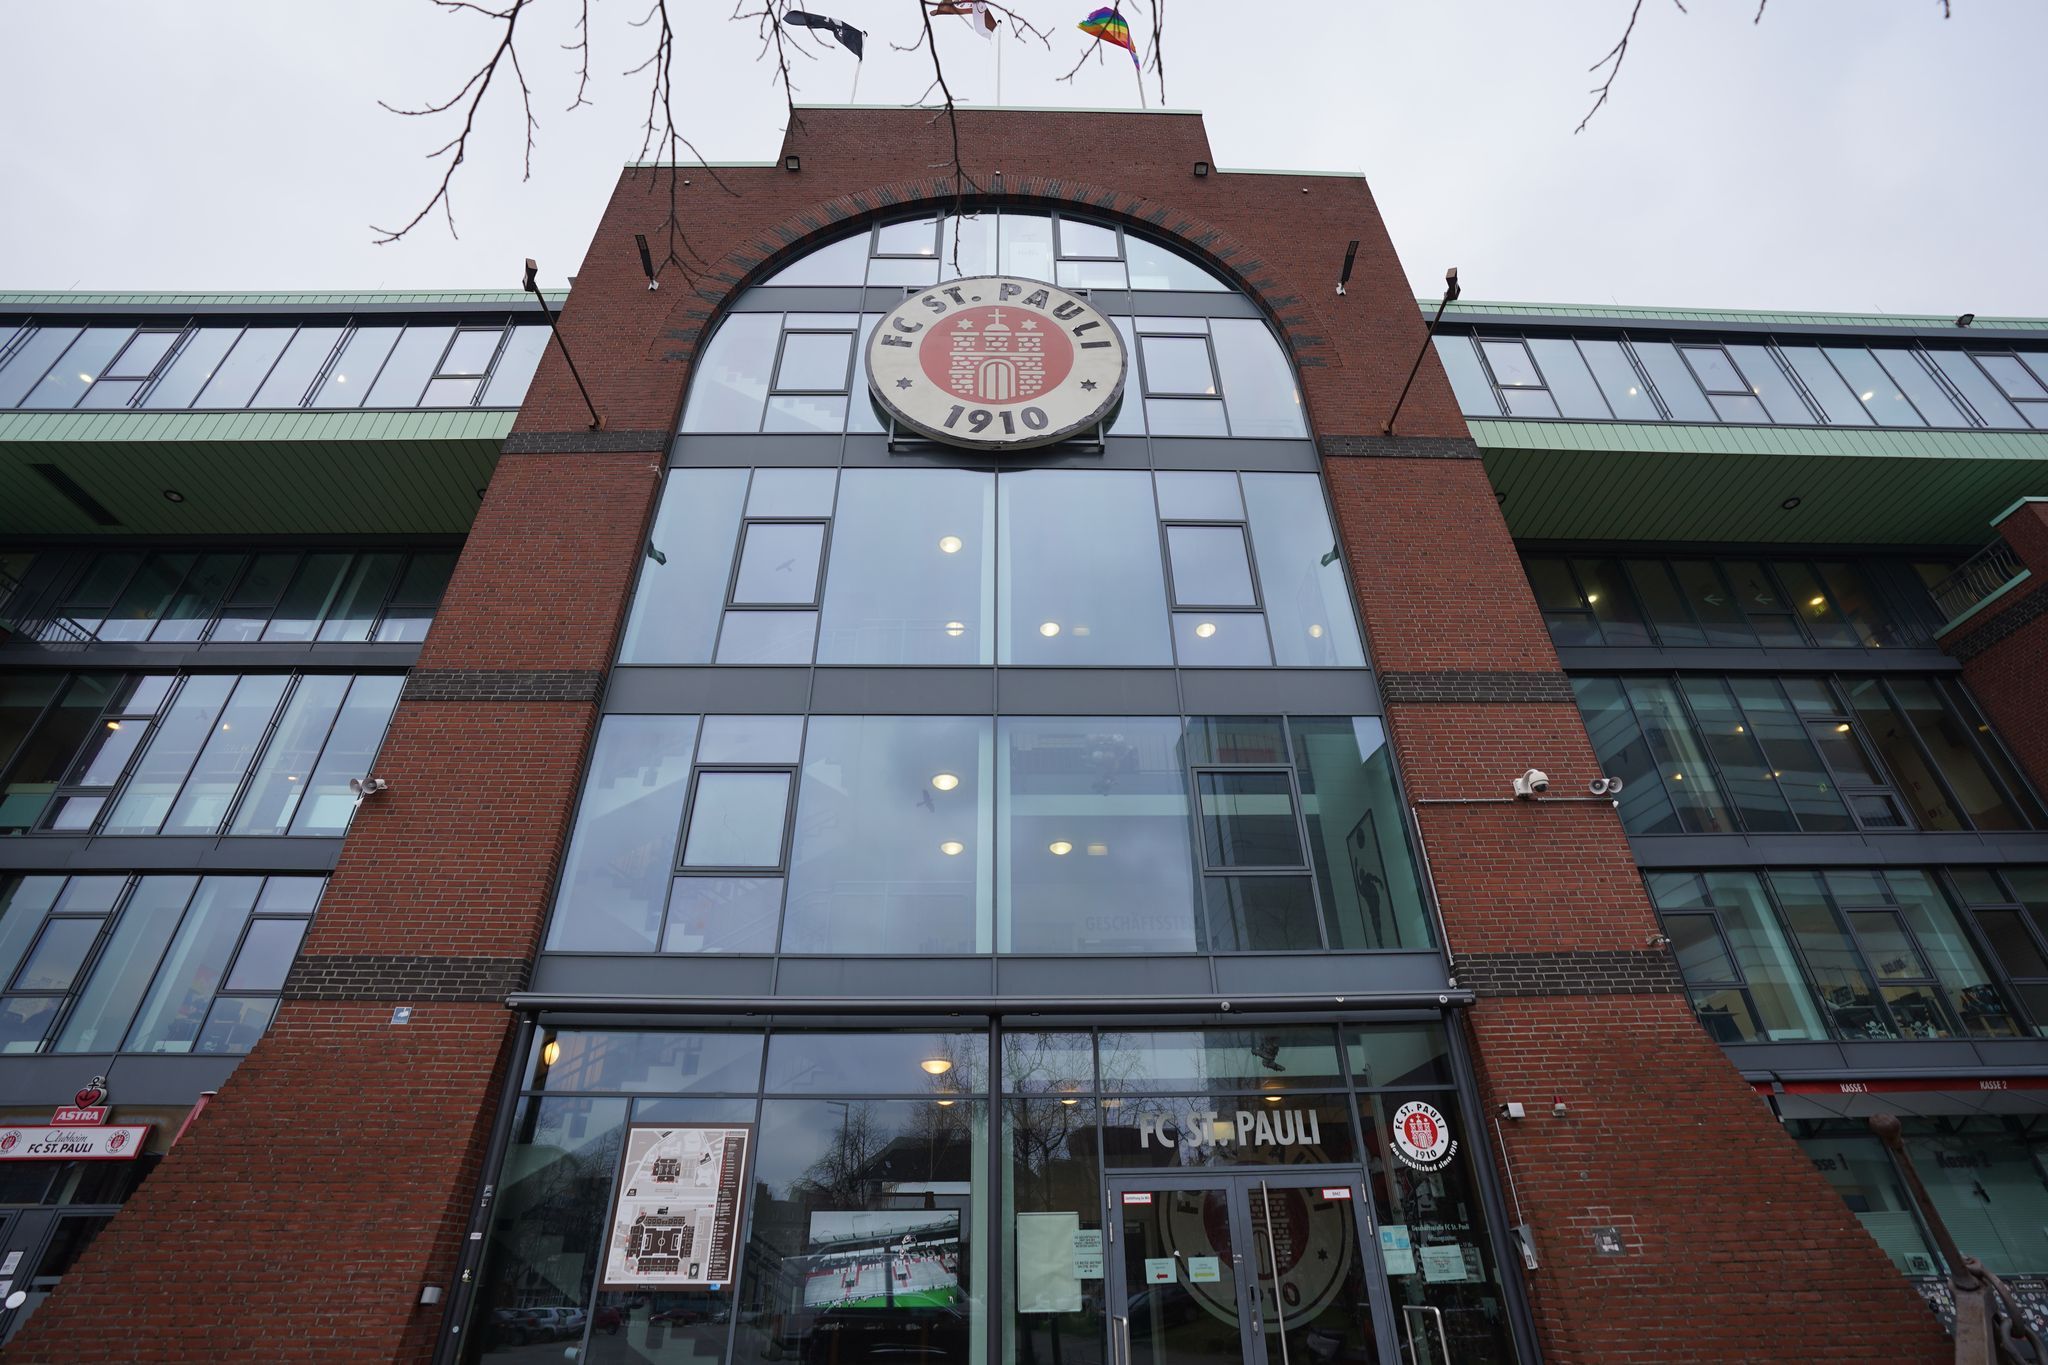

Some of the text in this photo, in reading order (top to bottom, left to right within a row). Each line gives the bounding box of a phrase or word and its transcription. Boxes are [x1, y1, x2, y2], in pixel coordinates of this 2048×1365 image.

[881, 282, 1112, 350] FC ST. PAULI
[943, 404, 1049, 435] 1910
[1840, 1082, 1868, 1093] KASSE 1
[1980, 1080, 2008, 1090] KASSE 2
[56, 1111, 99, 1121] ASTRA
[1396, 1103, 1445, 1130] FC ST. PAULI
[45, 1129, 88, 1142] Clubheim
[1140, 1109, 1321, 1149] FC ST. PAULI
[27, 1143, 94, 1153] FC ST. PAULI
[1415, 1149, 1437, 1160] 1910
[1398, 1155, 1438, 1172] established
[1438, 1156, 1453, 1169] since
[1449, 1140, 1458, 1157] 1910
